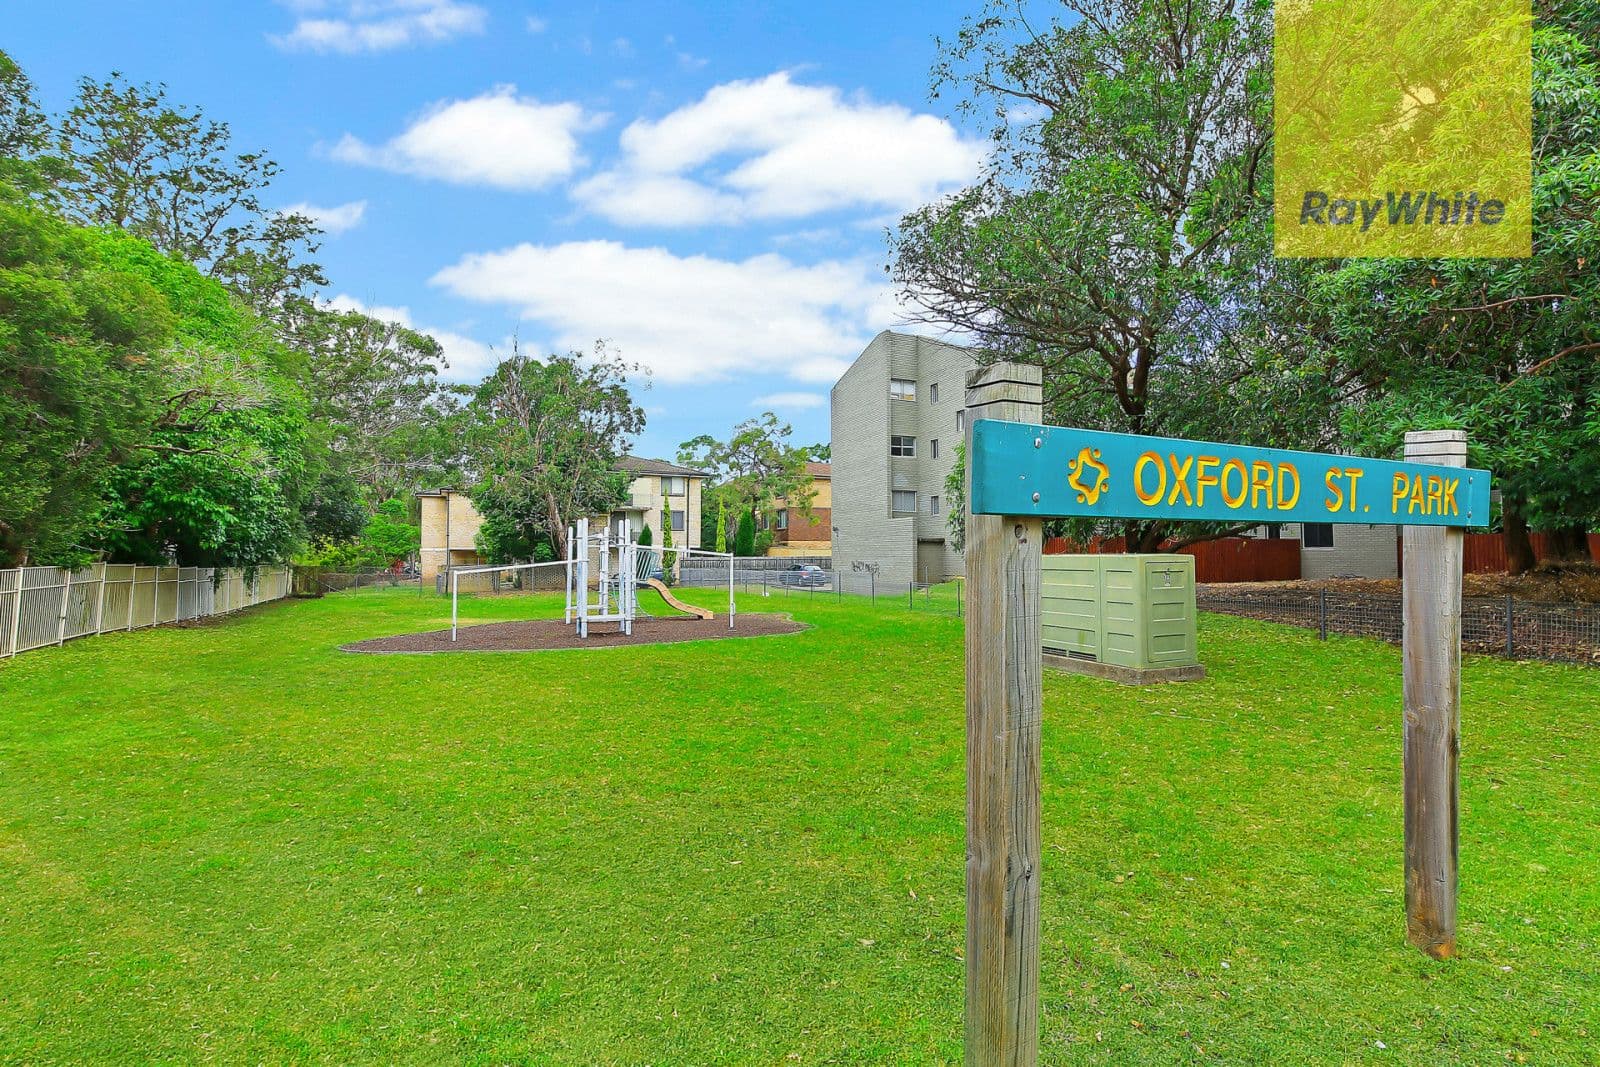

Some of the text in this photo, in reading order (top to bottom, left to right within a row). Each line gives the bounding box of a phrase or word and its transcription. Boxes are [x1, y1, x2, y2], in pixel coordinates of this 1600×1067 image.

[1134, 451, 1459, 516] OXFORD ST. PARK
